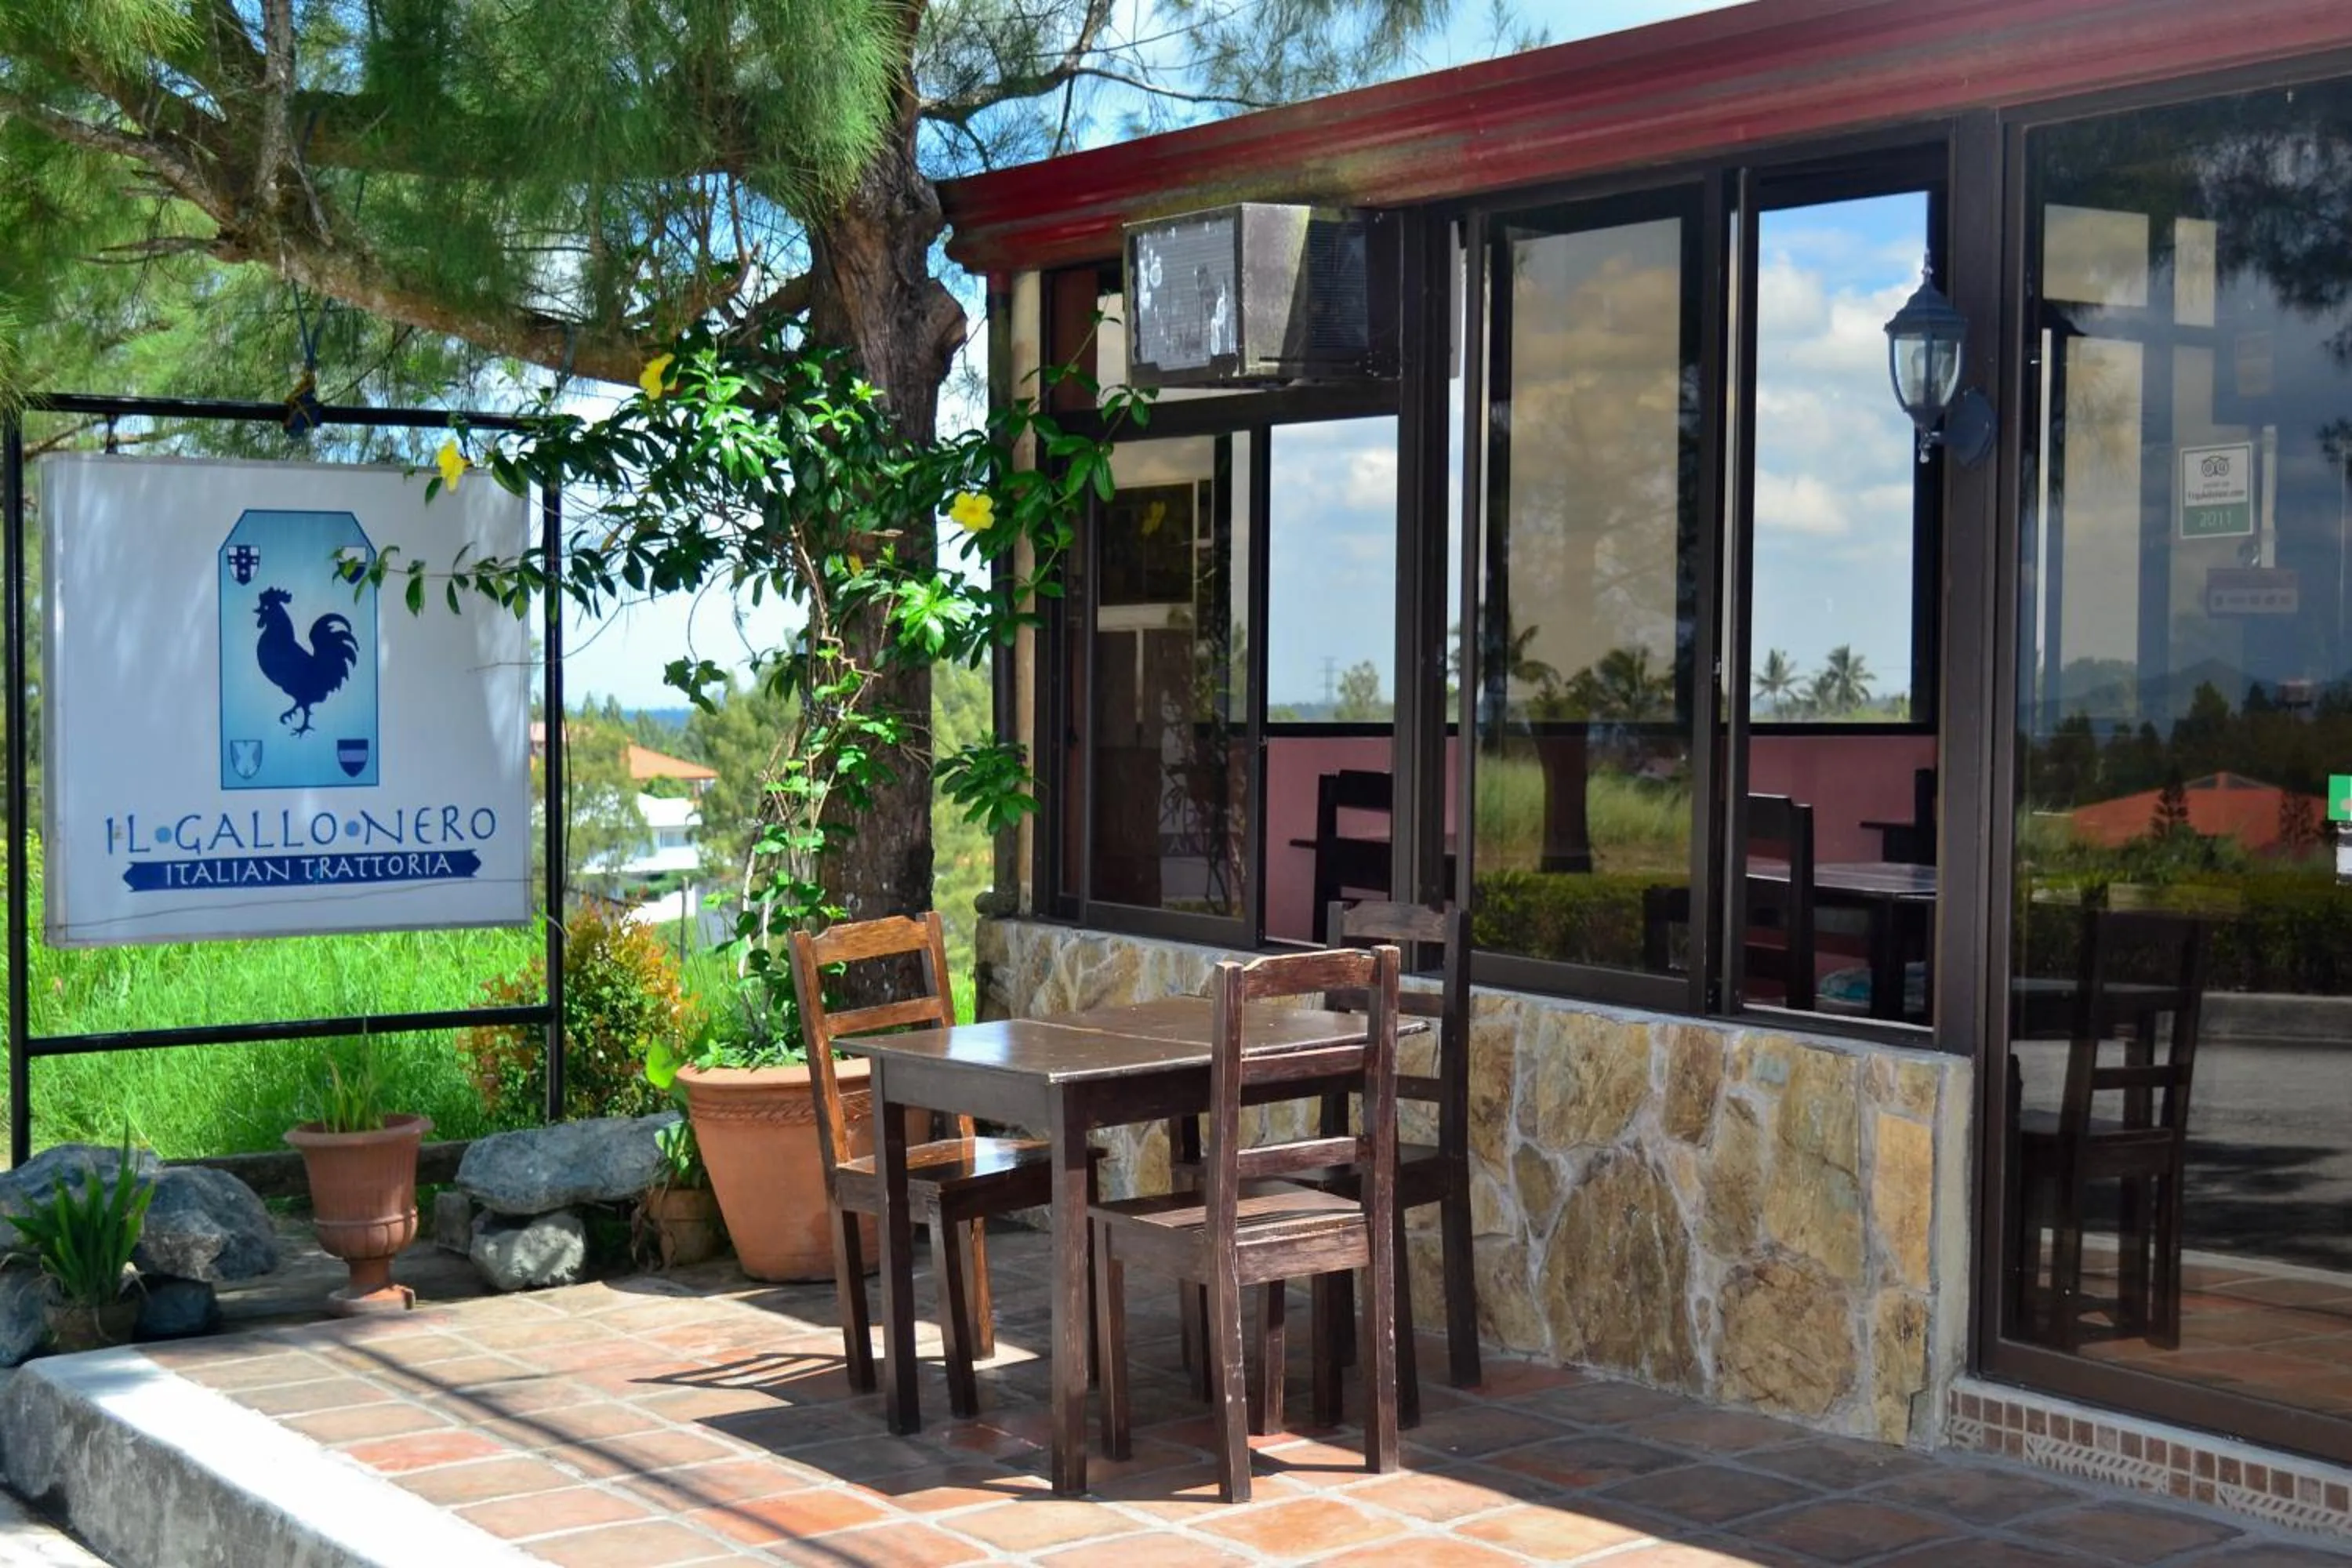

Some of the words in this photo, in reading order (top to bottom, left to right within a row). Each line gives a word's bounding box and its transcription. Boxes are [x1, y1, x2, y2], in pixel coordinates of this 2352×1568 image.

[2200, 510, 2232, 528] 2011
[106, 815, 151, 855] IL
[175, 810, 337, 855] GALLO
[360, 805, 496, 845] NERO
[165, 860, 289, 886] ITALIAN
[301, 852, 452, 879] TRATTORIA
